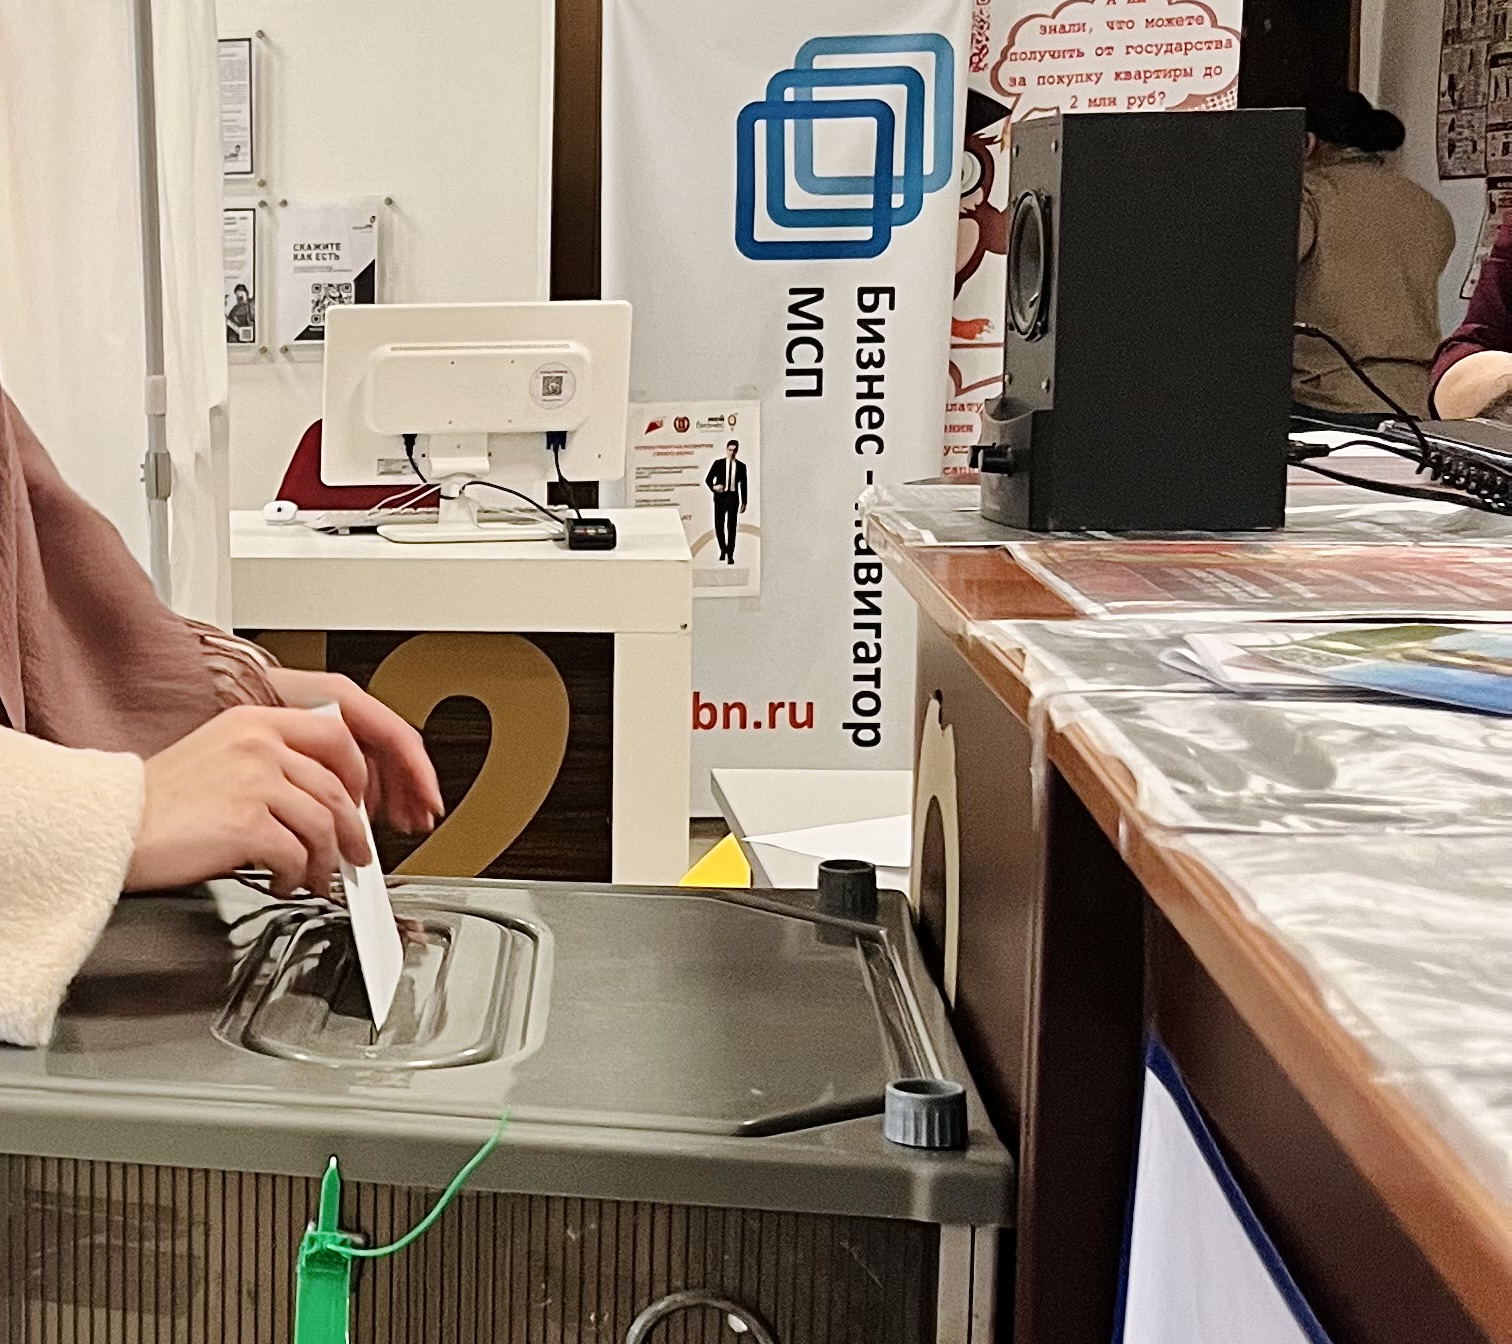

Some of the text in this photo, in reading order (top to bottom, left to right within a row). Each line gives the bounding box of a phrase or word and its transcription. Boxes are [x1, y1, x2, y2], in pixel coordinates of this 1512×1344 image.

[1039, 15, 1205, 36] знали, что можете
[1009, 38, 1233, 63] получить от государства
[1008, 65, 1223, 88] за покупку квартиры до
[1070, 91, 1167, 110] 2 млн руб?
[293, 242, 341, 252] СКАЖИТЕ
[293, 252, 340, 261] КАК ЕСТЬ
[785, 287, 825, 398] МСП
[854, 286, 896, 455] Бизнес
[842, 503, 883, 748] авигатор
[691, 690, 814, 730] bn.ru
